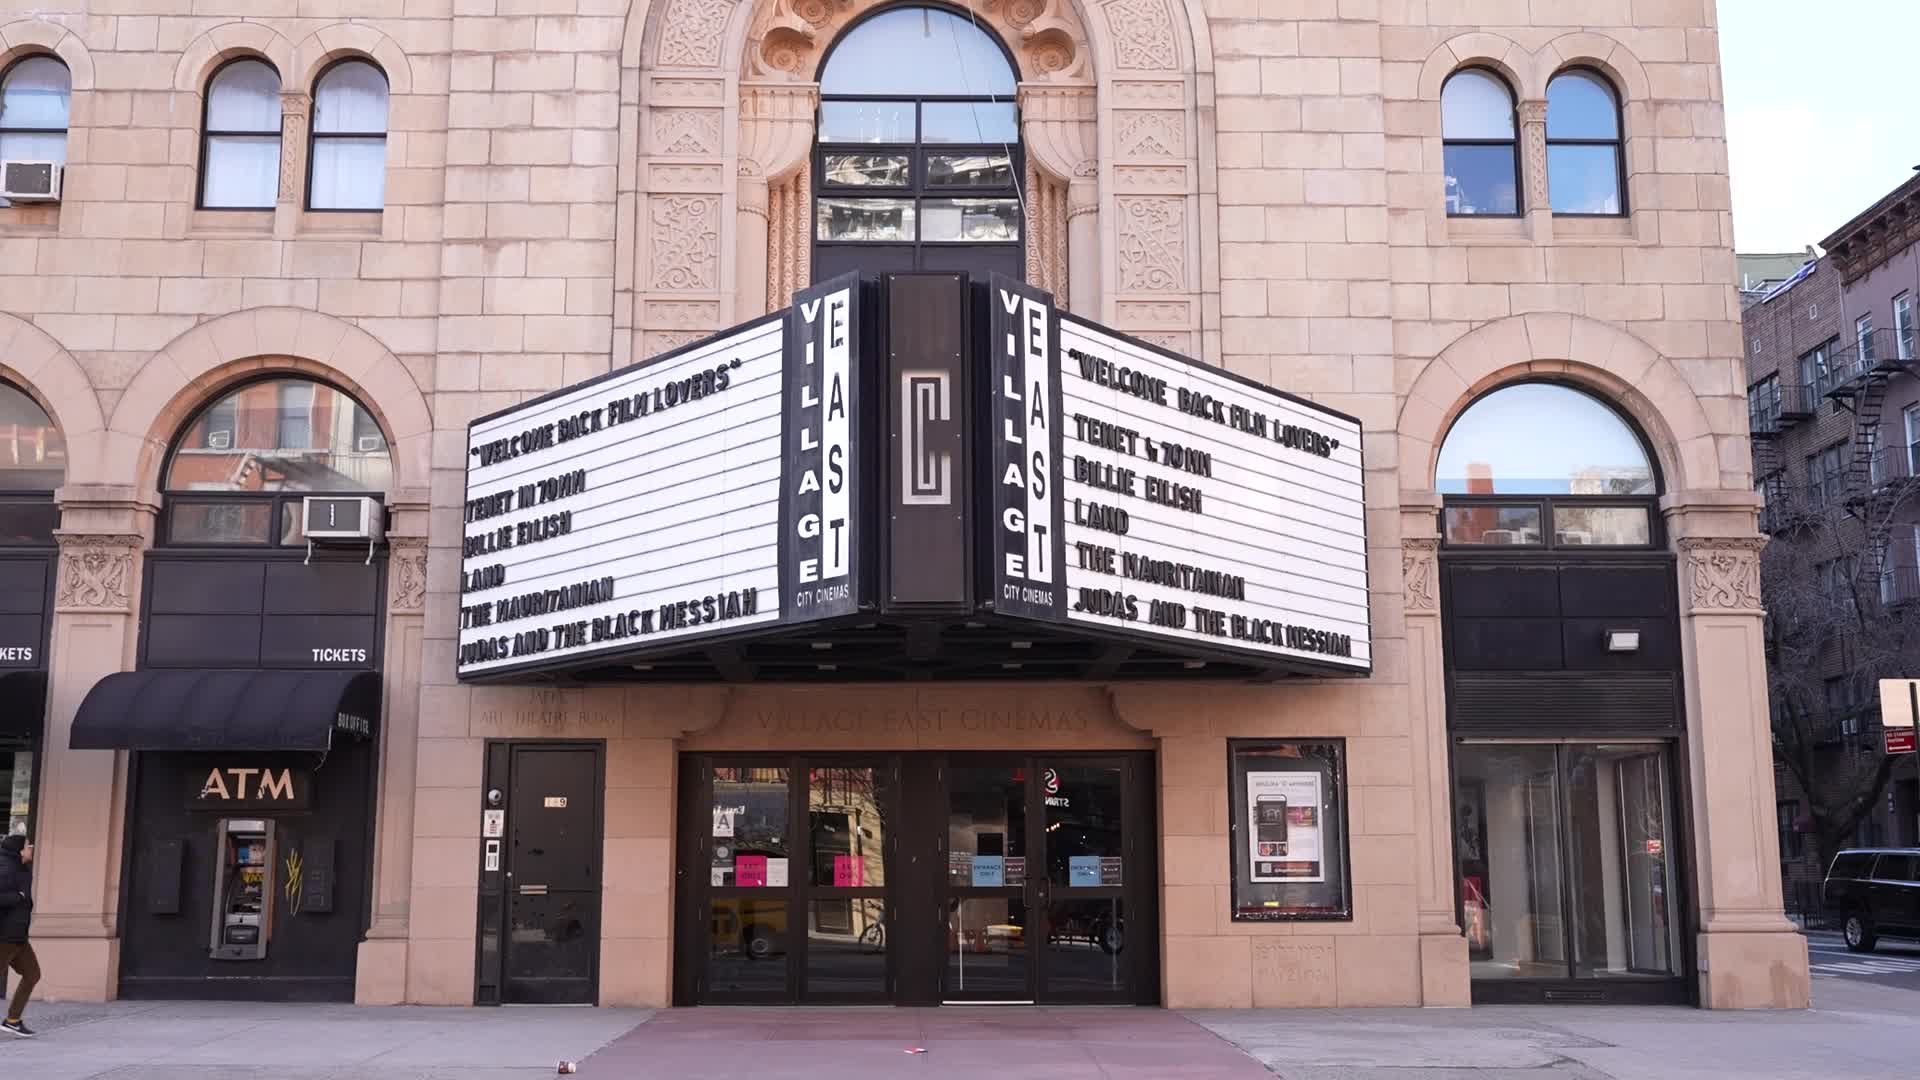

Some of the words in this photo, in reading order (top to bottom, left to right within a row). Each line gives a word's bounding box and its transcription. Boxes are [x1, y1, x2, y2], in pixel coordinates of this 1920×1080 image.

[557, 408, 602, 444] BACK
[607, 392, 649, 427] FILM
[828, 300, 845, 569] EAST
[1000, 289, 1025, 579] VILLAGE
[1178, 386, 1225, 425] BACK
[1230, 404, 1267, 438] FILM
[797, 298, 822, 584] VILLAGE
[1028, 306, 1047, 574] EAST
[1074, 412, 1139, 457] TENET
[1161, 441, 1212, 478] 70MM
[465, 489, 514, 523] TENET
[518, 483, 536, 510] IN
[537, 468, 586, 504] 70MM
[1074, 455, 1136, 497] BILLIE
[1145, 475, 1202, 514] EILISH
[463, 524, 513, 559] BILLIE
[517, 510, 572, 546] EILISH
[1075, 498, 1130, 536] LAND
[462, 563, 506, 594] LAND
[797, 590, 813, 607] CITY
[816, 584, 849, 603] CINEMAS
[1004, 583, 1020, 601] CITY
[1022, 586, 1053, 607] CINEMAS
[1077, 541, 1116, 576] THE
[1122, 552, 1245, 601] MAURITANIAN
[459, 635, 509, 665] JUDAS
[511, 627, 549, 657] AND
[553, 620, 586, 649] THE
[591, 609, 655, 642] BLACK
[659, 587, 757, 632] MESSIAH
[461, 602, 492, 629] THE
[496, 576, 614, 623] MAURITANIAN
[1074, 587, 1138, 622] JUDAS
[1149, 599, 1186, 629] AND
[1193, 606, 1227, 637] THE
[1231, 614, 1283, 647] BLACK
[1286, 624, 1351, 658] MESSIAH
[312, 648, 367, 663] TICKETS
[757, 711, 866, 732] VILLAGE
[884, 710, 948, 731] EAST
[960, 710, 1088, 731] CINEMAS
[198, 768, 295, 800] ATM
